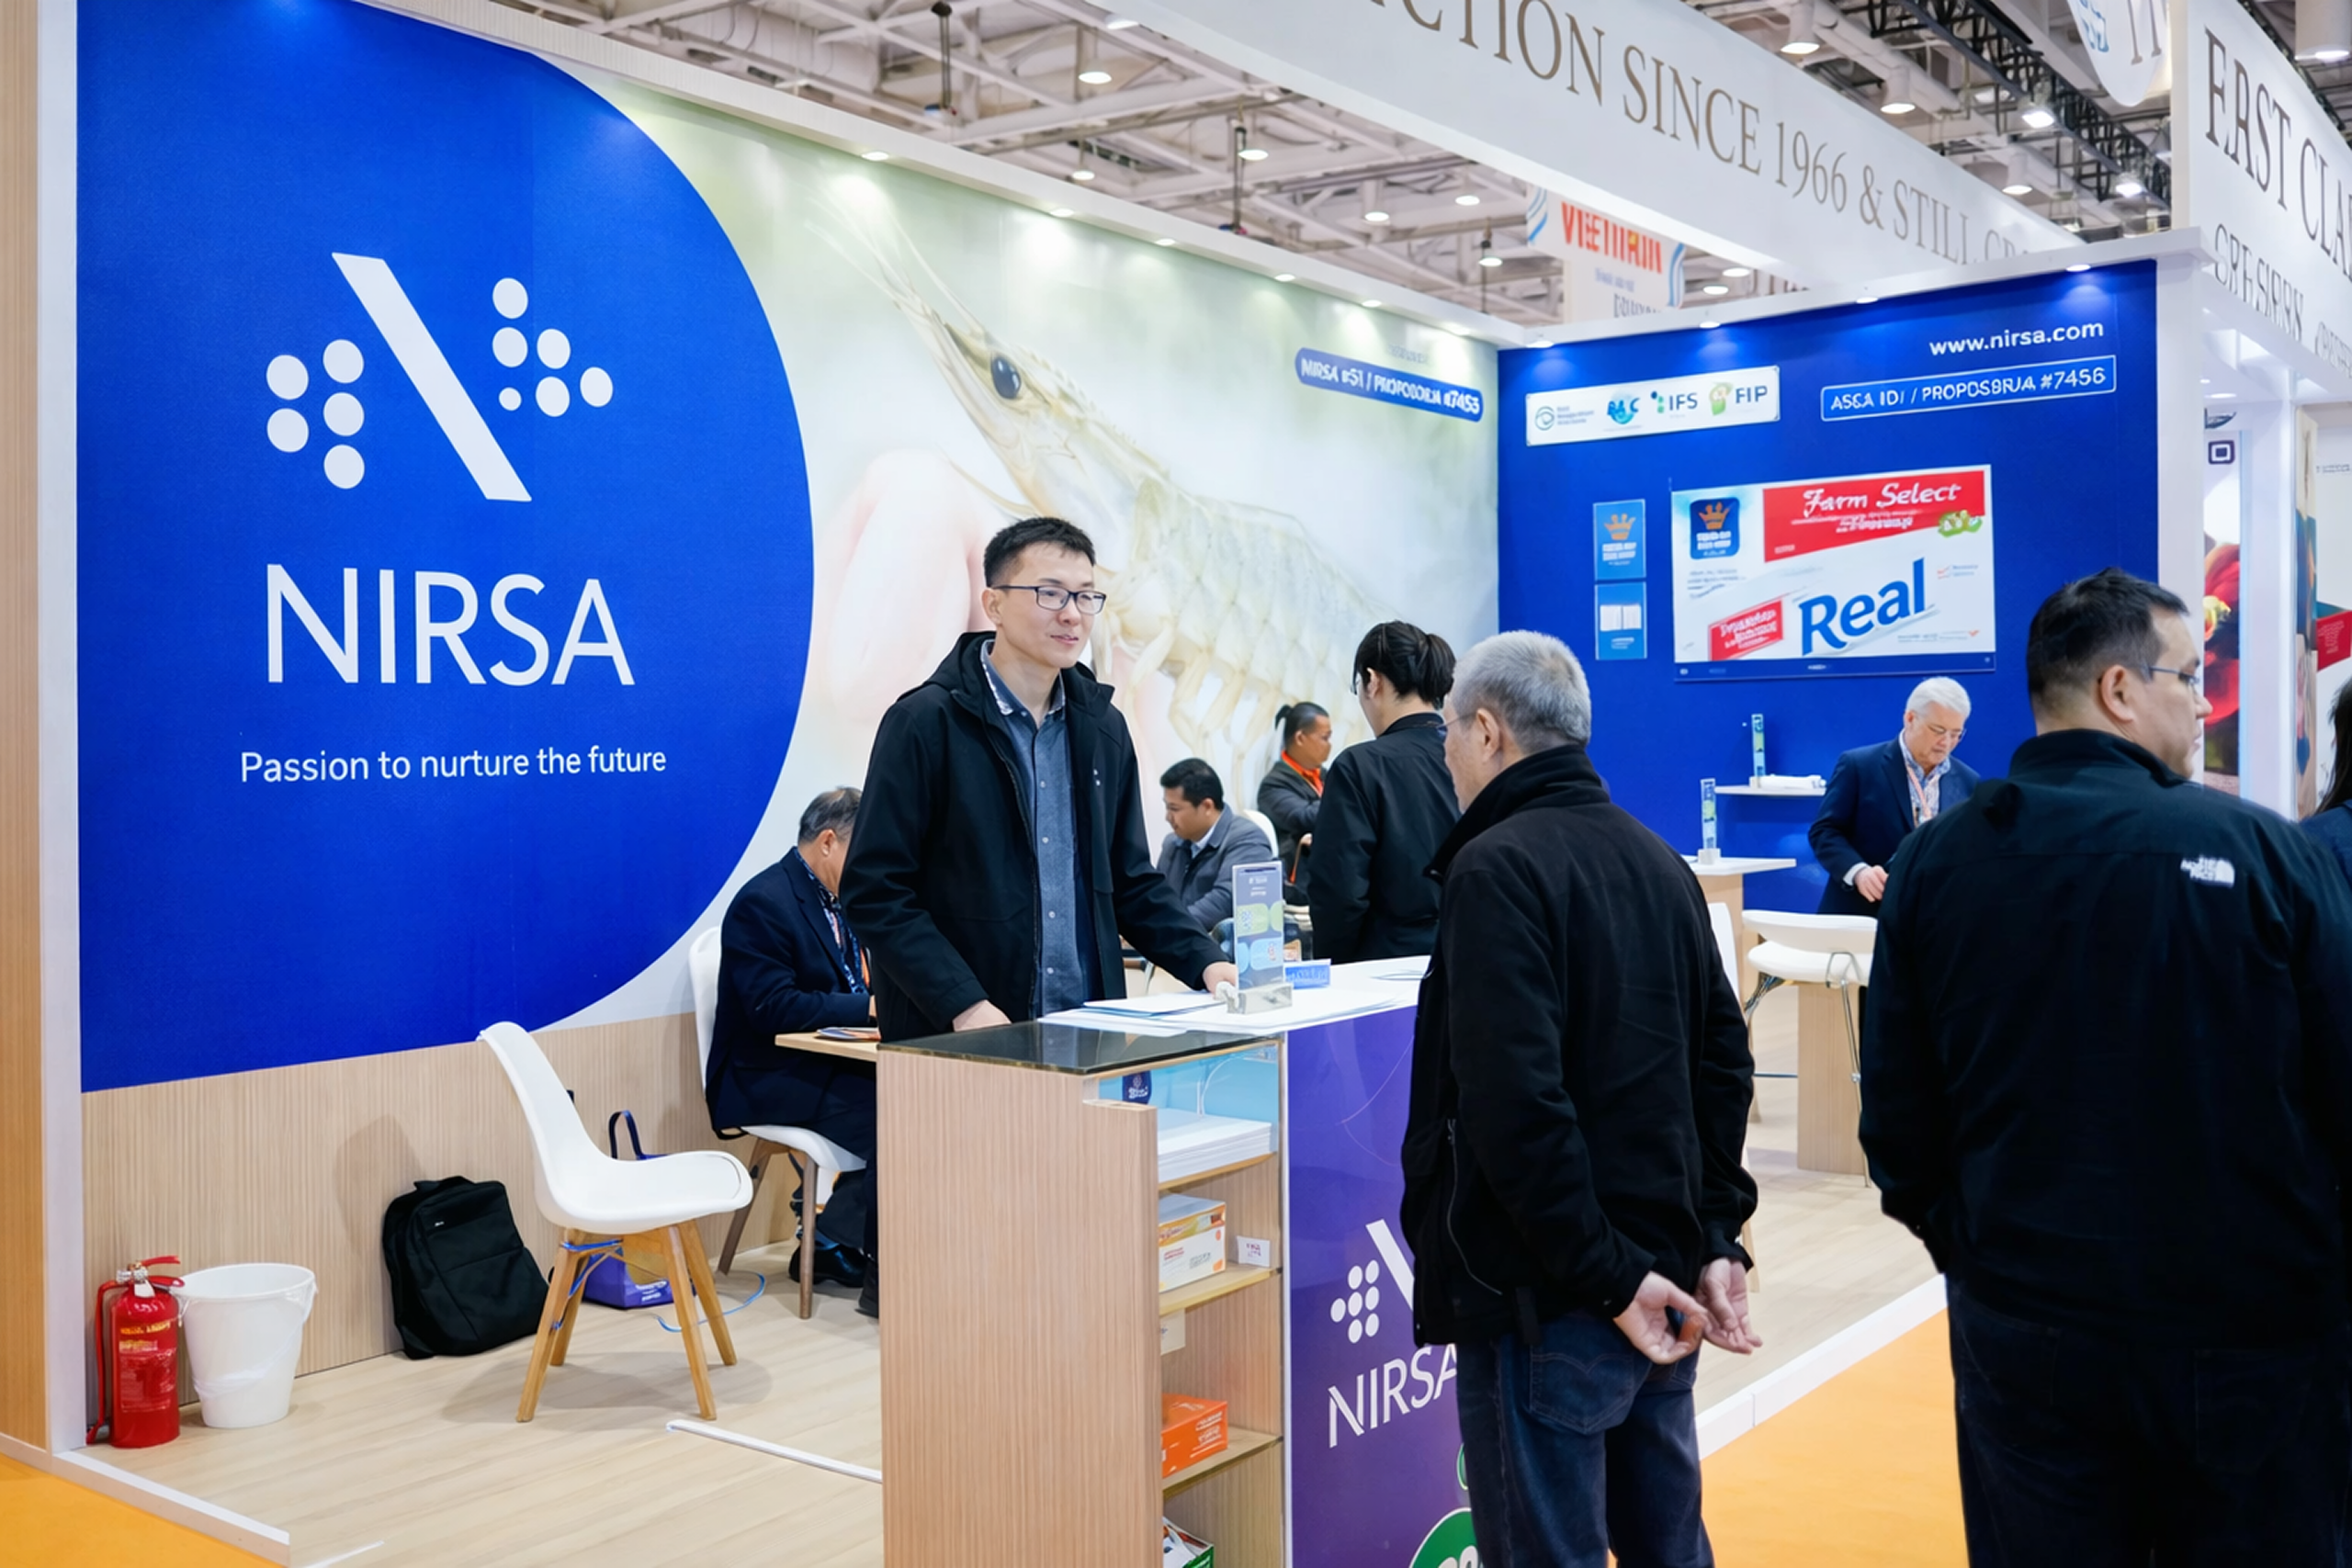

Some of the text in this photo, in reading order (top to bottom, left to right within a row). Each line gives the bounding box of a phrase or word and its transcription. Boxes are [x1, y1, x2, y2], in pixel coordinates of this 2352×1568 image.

[1623, 45, 1762, 176] SINCE
[1775, 121, 1847, 212] 1966
[1860, 164, 1884, 231] &
[1929, 321, 2104, 355] www.nirsa.com
[1668, 392, 1699, 411] IFS
[1735, 385, 1768, 404] FIP
[1803, 481, 1962, 517] Farm Select
[267, 563, 636, 686] NIRSA
[1798, 557, 1926, 656] Real
[241, 745, 667, 782] Passion to nurture the future
[1328, 1343, 1457, 1449] NIRSA
